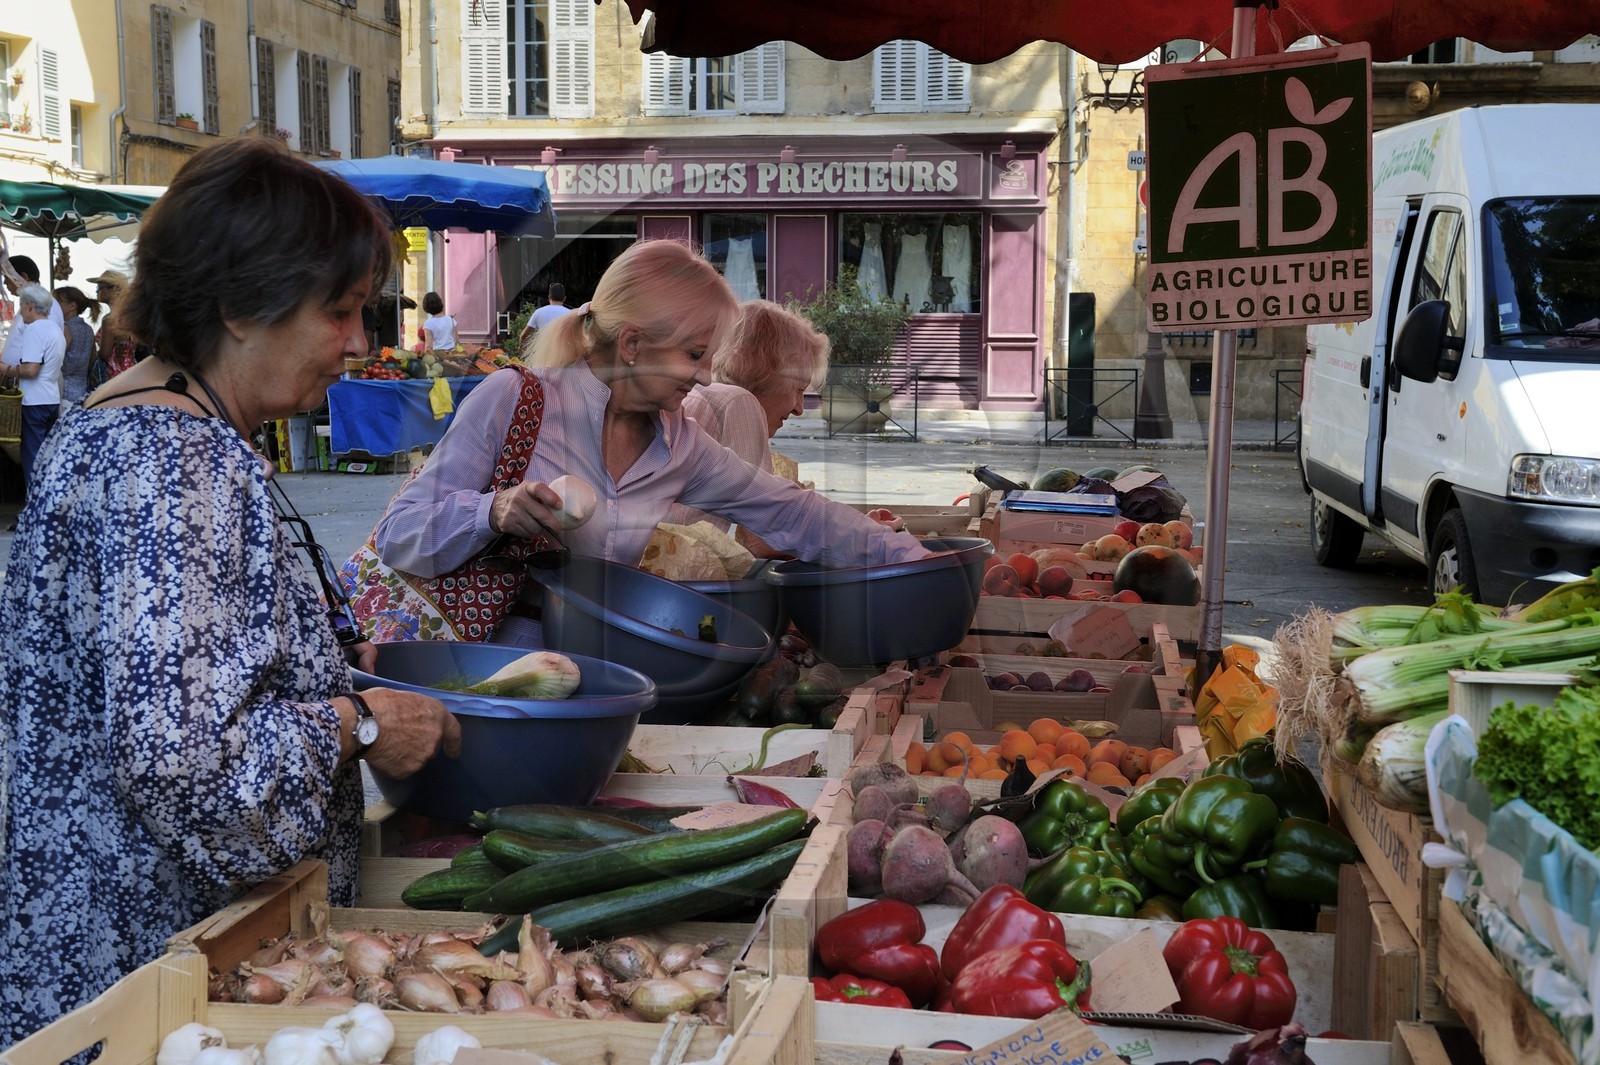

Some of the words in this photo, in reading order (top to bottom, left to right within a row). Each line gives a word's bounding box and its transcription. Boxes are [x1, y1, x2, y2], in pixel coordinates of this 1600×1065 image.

[513, 163, 674, 195] RESSING
[683, 162, 747, 194] DES
[756, 160, 958, 193] PRECHEURS
[1167, 126, 1338, 254] AB
[1151, 258, 1370, 292] AGRICULTURE
[1152, 290, 1370, 322] BIOLOGIQUE
